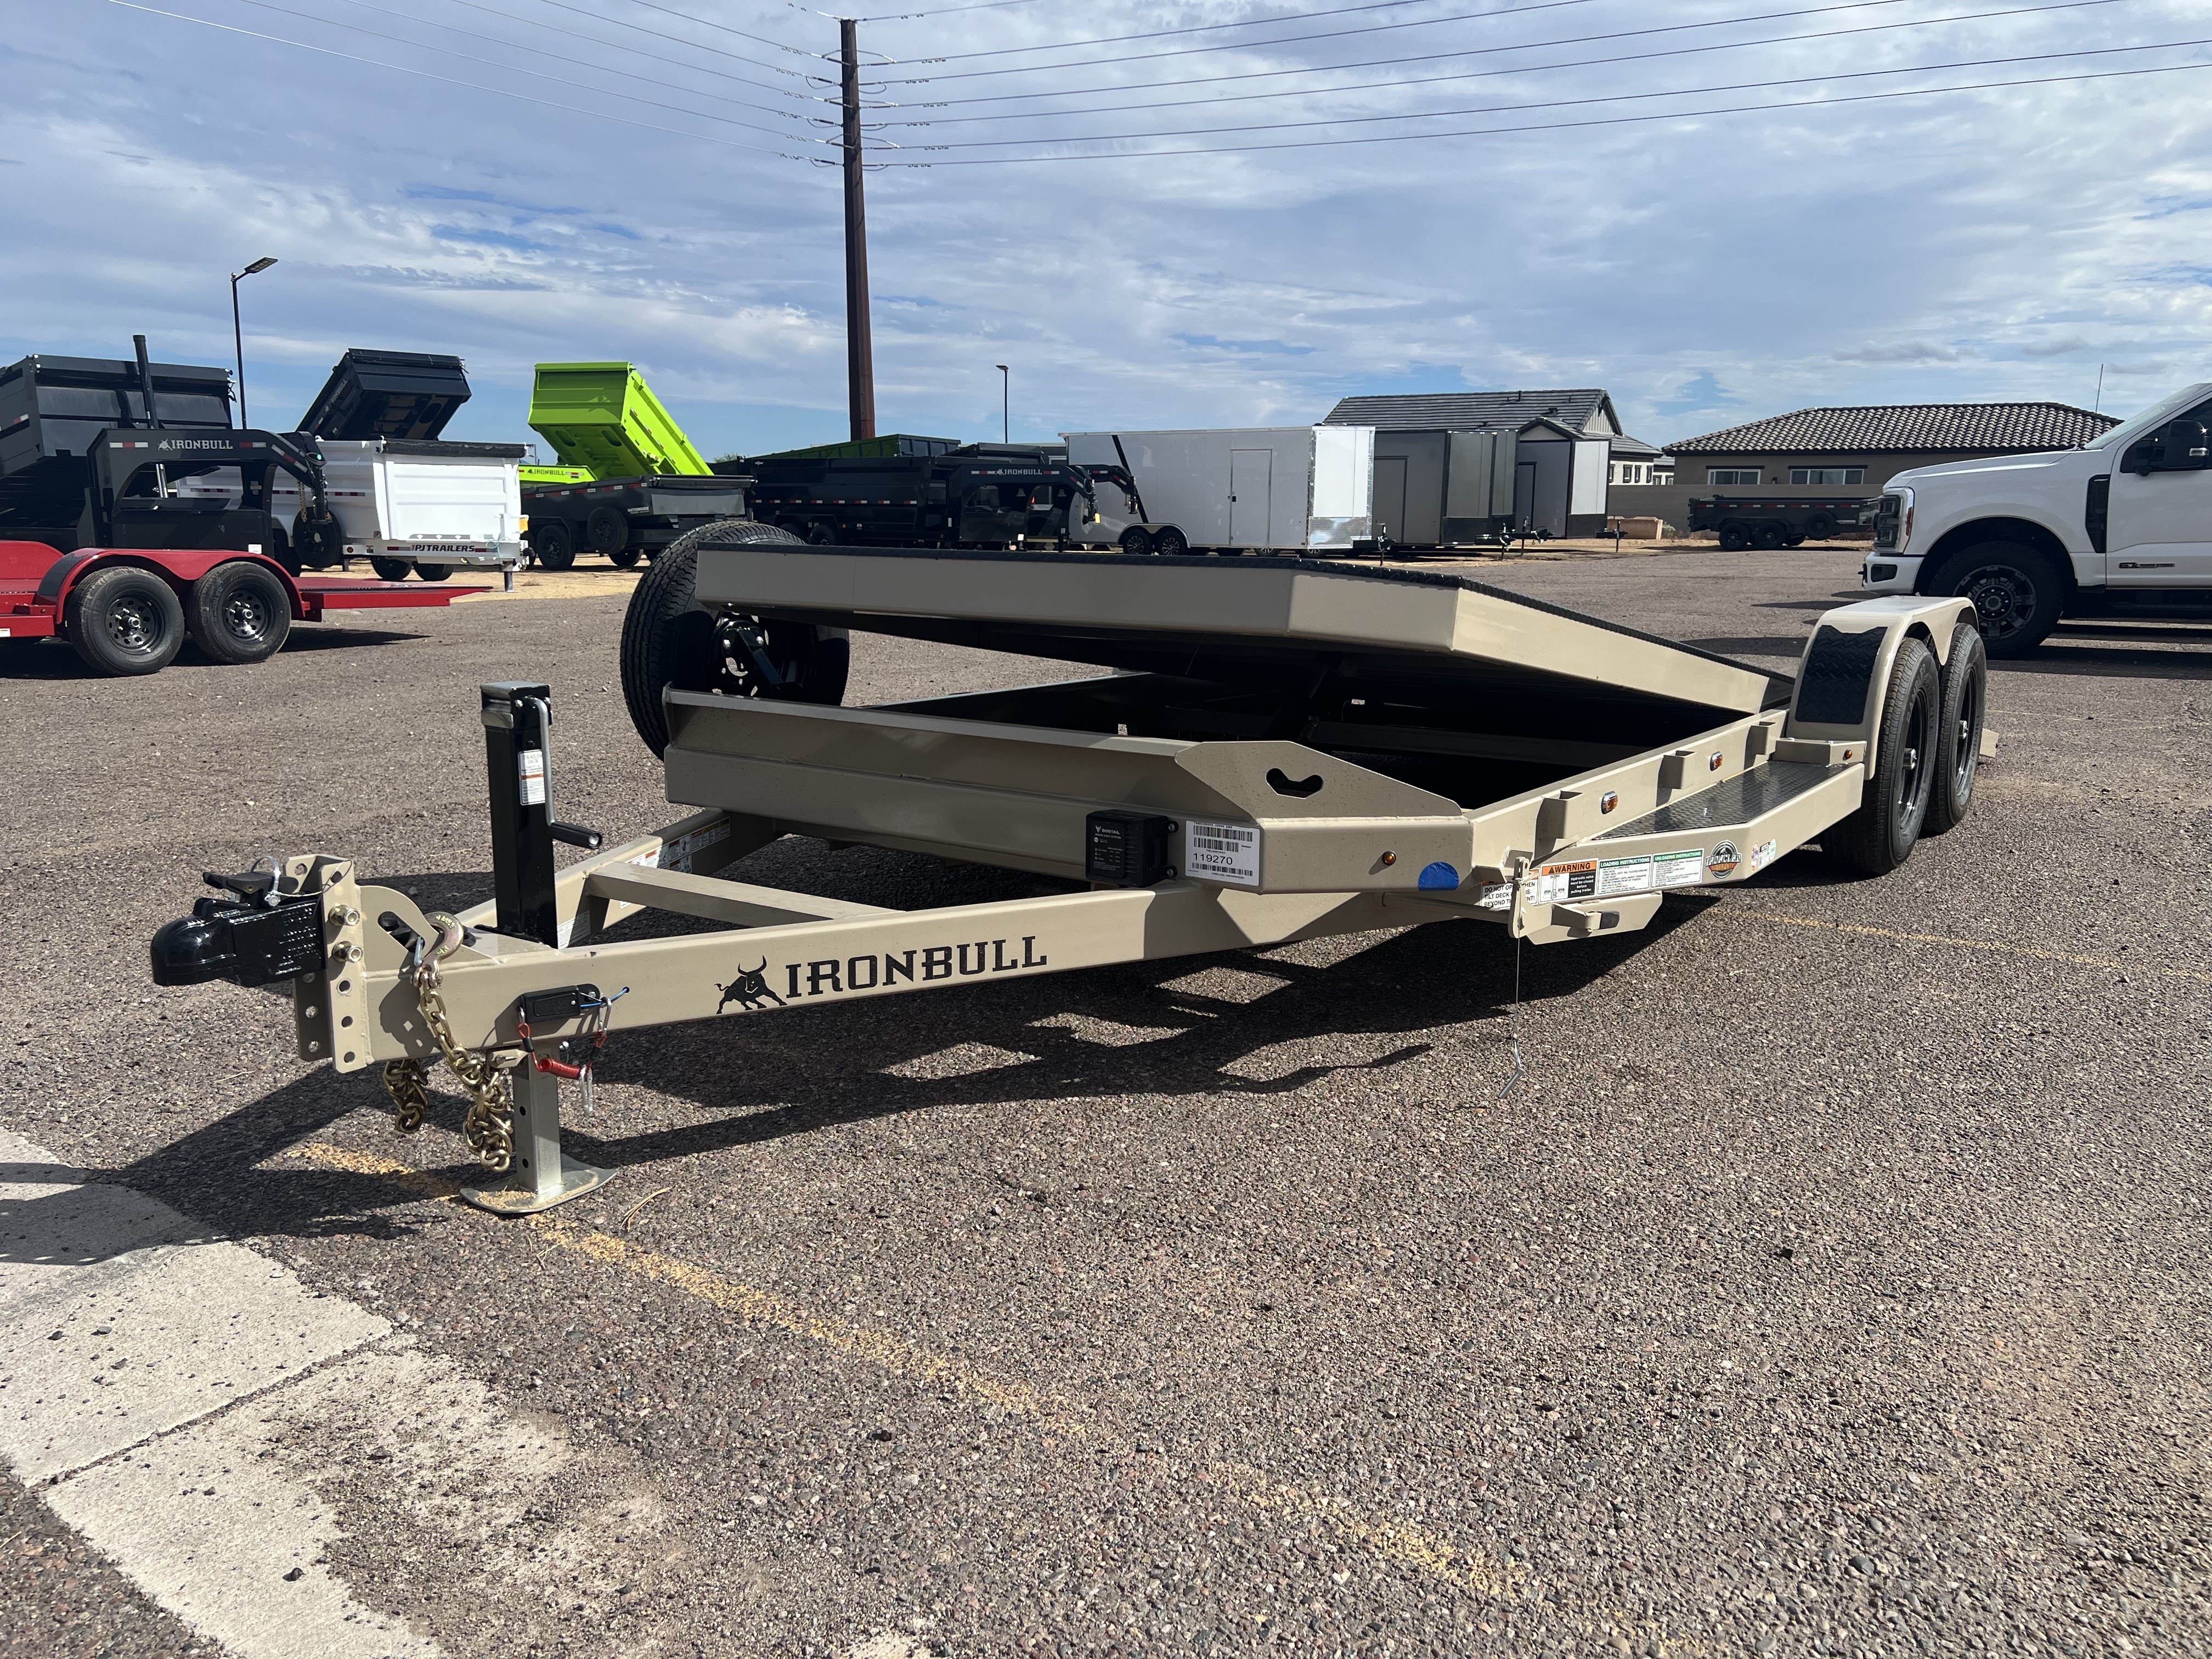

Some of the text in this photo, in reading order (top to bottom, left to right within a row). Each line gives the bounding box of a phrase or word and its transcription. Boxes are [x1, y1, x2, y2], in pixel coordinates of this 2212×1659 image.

[171, 440, 233, 449] IRONBULL
[1193, 853, 1233, 865] 119270
[1555, 863, 1590, 873] WARNING
[785, 936, 1048, 998] IRONBULL
